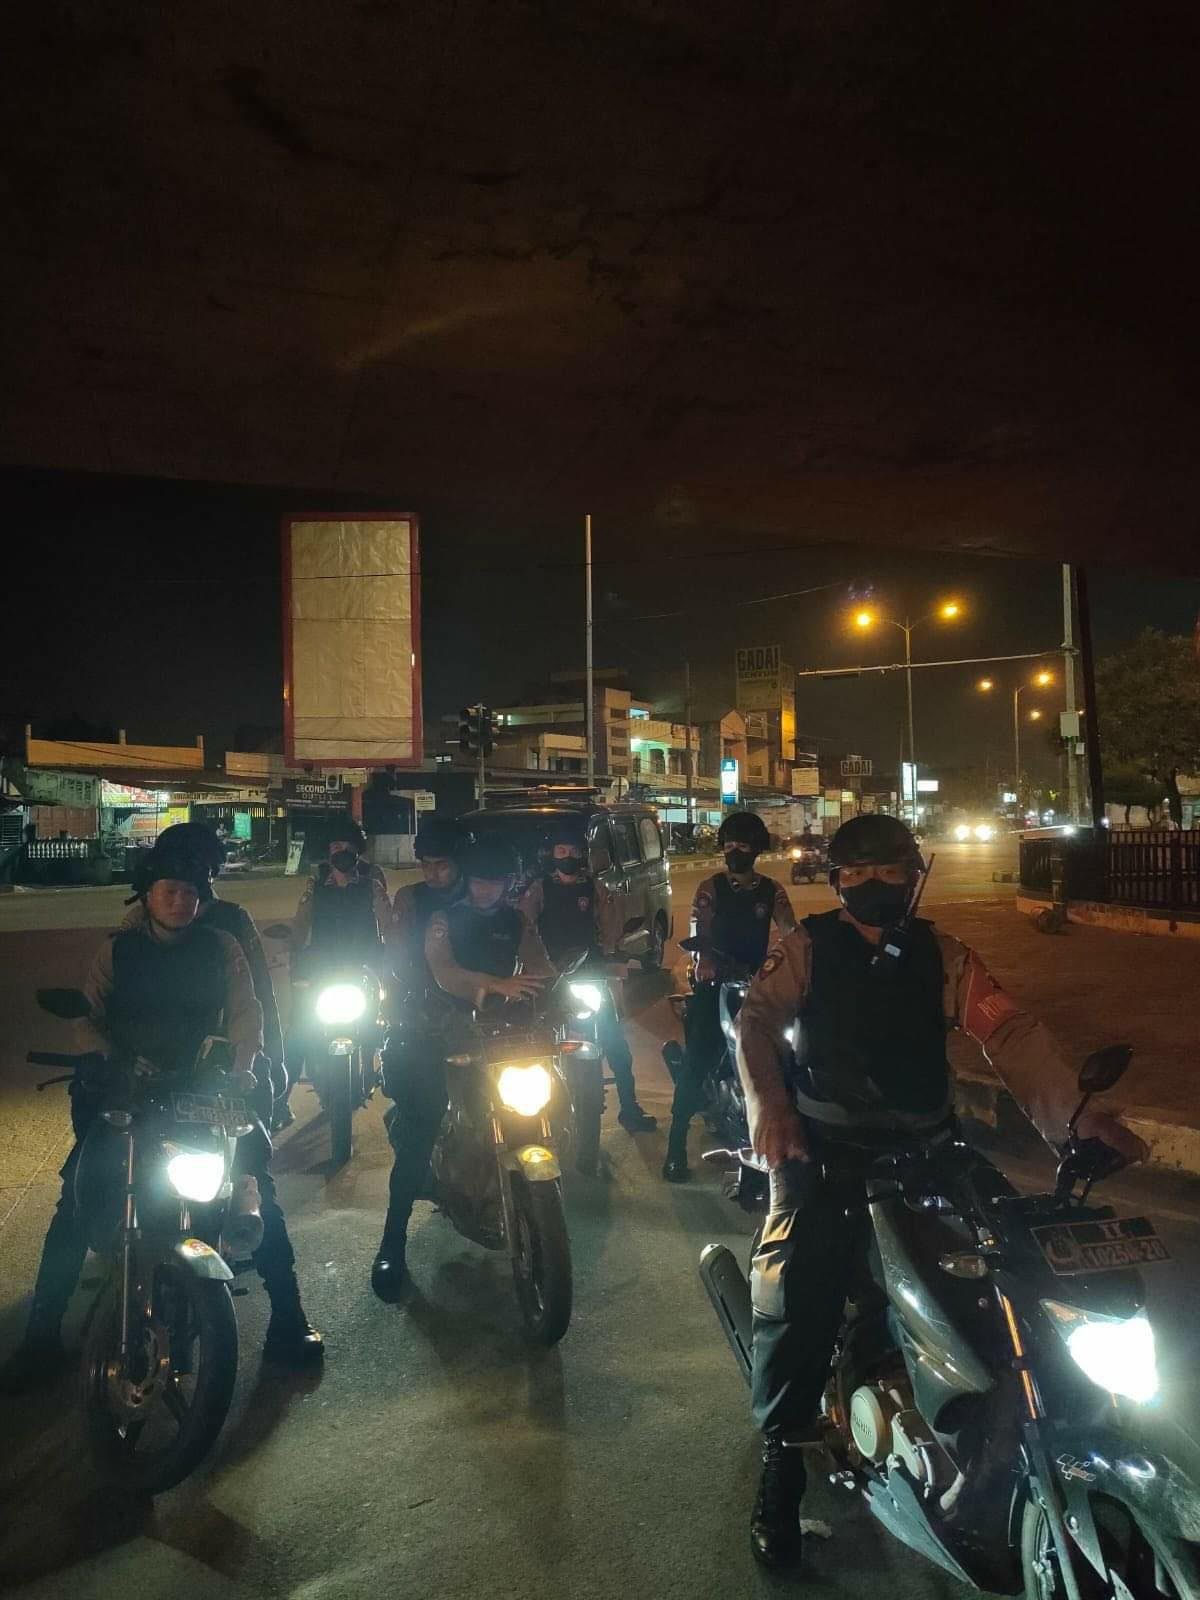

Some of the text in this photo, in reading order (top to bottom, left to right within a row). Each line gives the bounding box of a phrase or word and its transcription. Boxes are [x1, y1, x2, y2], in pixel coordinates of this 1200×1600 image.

[737, 648, 779, 671] GADAI
[841, 760, 871, 775] GADAI
[295, 784, 326, 793] SECOND
